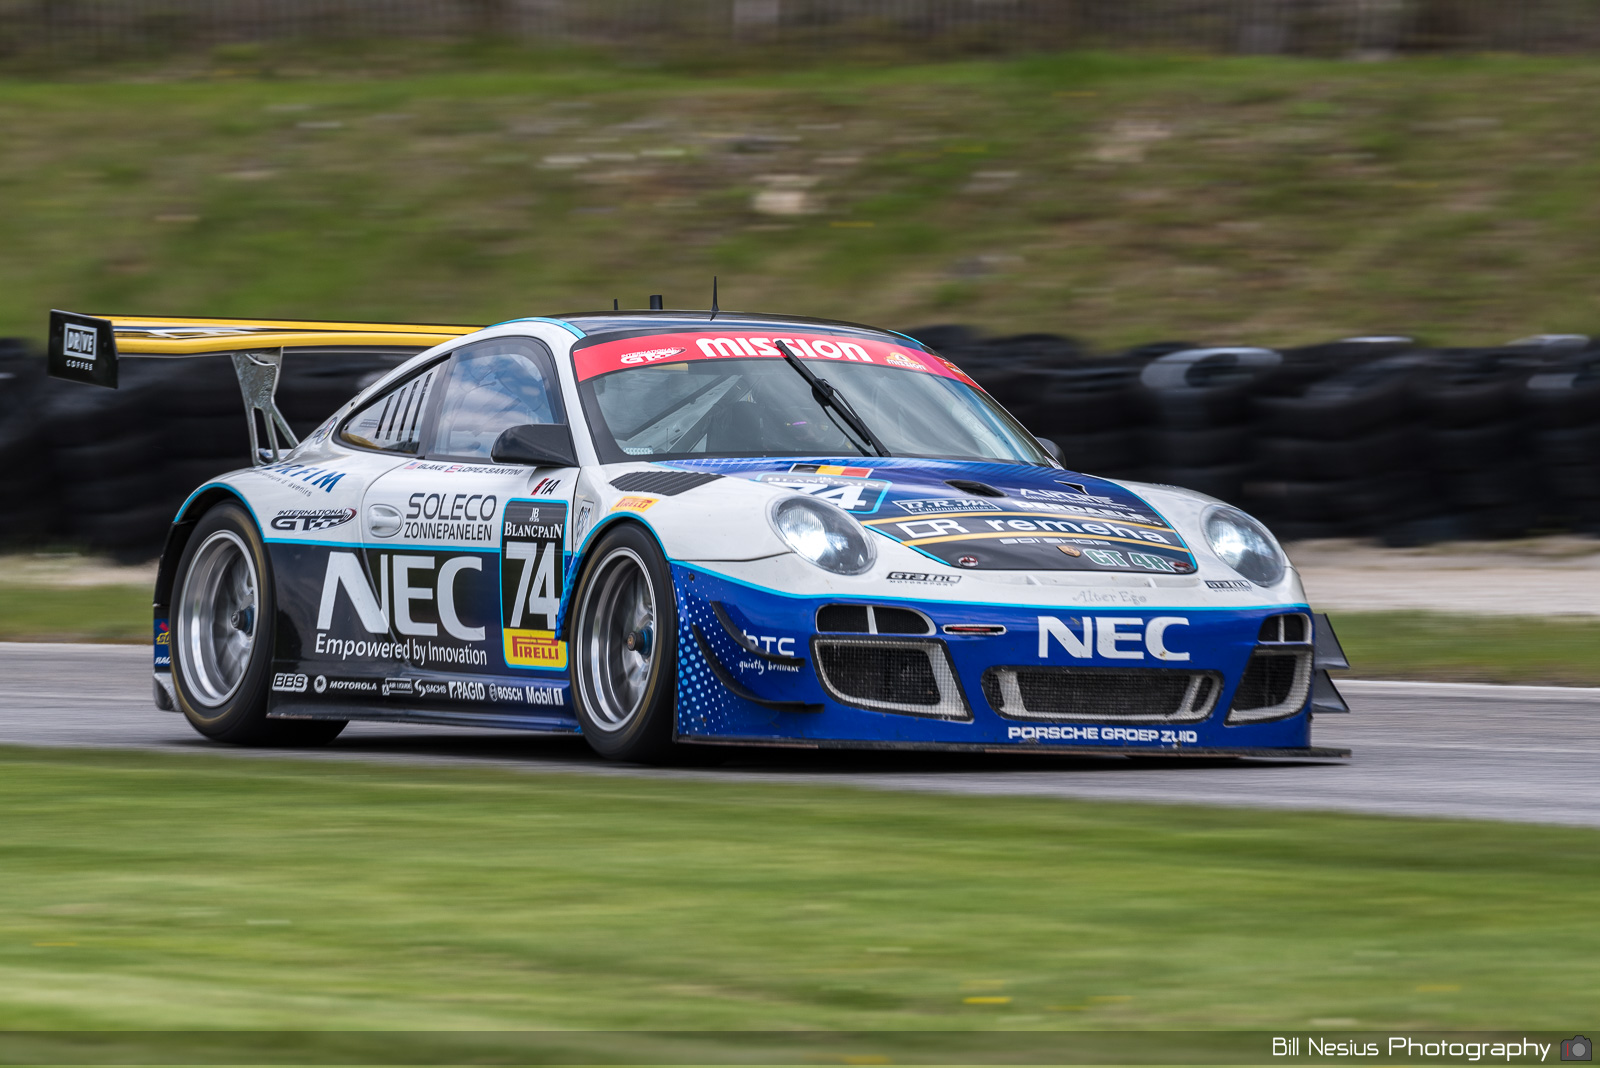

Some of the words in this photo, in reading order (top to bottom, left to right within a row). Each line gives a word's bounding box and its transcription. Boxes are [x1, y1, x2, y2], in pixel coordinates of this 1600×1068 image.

[67, 331, 93, 352] DRIVE
[66, 359, 93, 371] COFFEE
[417, 463, 446, 471] BLAKE
[457, 466, 524, 476] LOPEZ-SANTINI
[616, 499, 653, 509] PIRELLI
[768, 481, 868, 510] 74
[406, 493, 497, 521] SOLECO
[404, 522, 493, 541] ZONNEPANELEN
[504, 521, 563, 539] BLANCPAIN
[984, 518, 1171, 545] remeha
[1083, 549, 1130, 567] GT
[1127, 552, 1176, 572] 4R
[506, 541, 560, 629] 74
[317, 551, 486, 641] NEC
[512, 636, 559, 660] PIRELLI
[1038, 615, 1191, 662] NEC
[315, 633, 410, 661] Empowered
[413, 638, 426, 666] by
[428, 640, 488, 666] Innovation
[329, 681, 377, 691] MOTOROLA
[425, 684, 447, 694] SACHS
[456, 681, 486, 701] PAGID
[497, 686, 524, 702] BOSCH
[525, 686, 553, 705] Mobil
[553, 687, 564, 706] 1
[1008, 726, 1099, 740] PORSCHE
[1101, 727, 1159, 742] GROEP
[1160, 730, 1198, 743] ZUID
